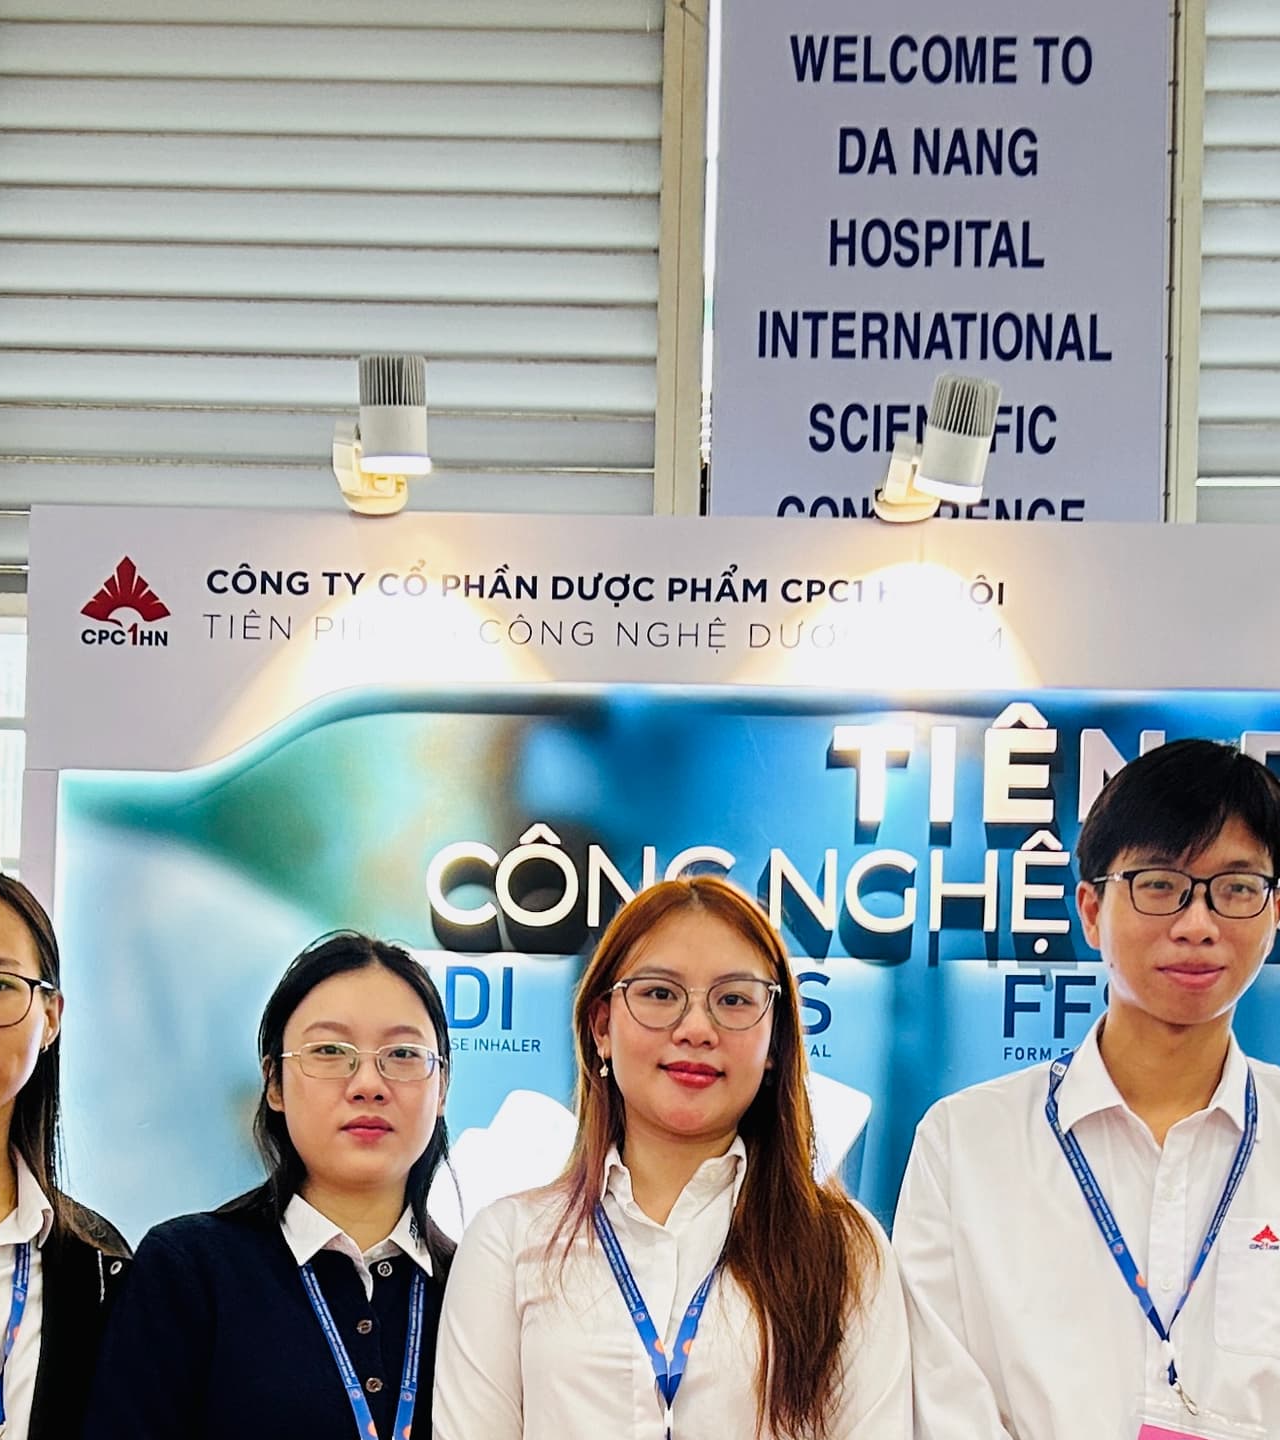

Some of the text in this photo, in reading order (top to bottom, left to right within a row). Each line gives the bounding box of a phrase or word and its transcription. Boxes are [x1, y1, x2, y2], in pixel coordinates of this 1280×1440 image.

[790, 34, 1093, 85] WELCOME TO
[838, 127, 1039, 177] DA NANG
[829, 218, 1045, 268] HOSPITAL
[757, 310, 1113, 362] INTERNATIONAL
[206, 563, 309, 596] CÔNG
[322, 572, 366, 596] TY
[378, 560, 428, 597] CỔ
[441, 563, 538, 601] PHẦN
[551, 573, 654, 607] DƯỢC
[667, 564, 768, 603] PHẨM
[780, 578, 863, 603] CPC1
[81, 621, 168, 646] CPC1HN
[203, 610, 291, 640] TIÊN
[479, 613, 594, 648] CÔNG
[616, 616, 726, 654] NGHỆ
[425, 822, 738, 929] CÔN
[769, 829, 1072, 955] NGHỆ
[474, 1038, 541, 1053] INHALER
[1003, 1047, 1053, 1061] FORM
